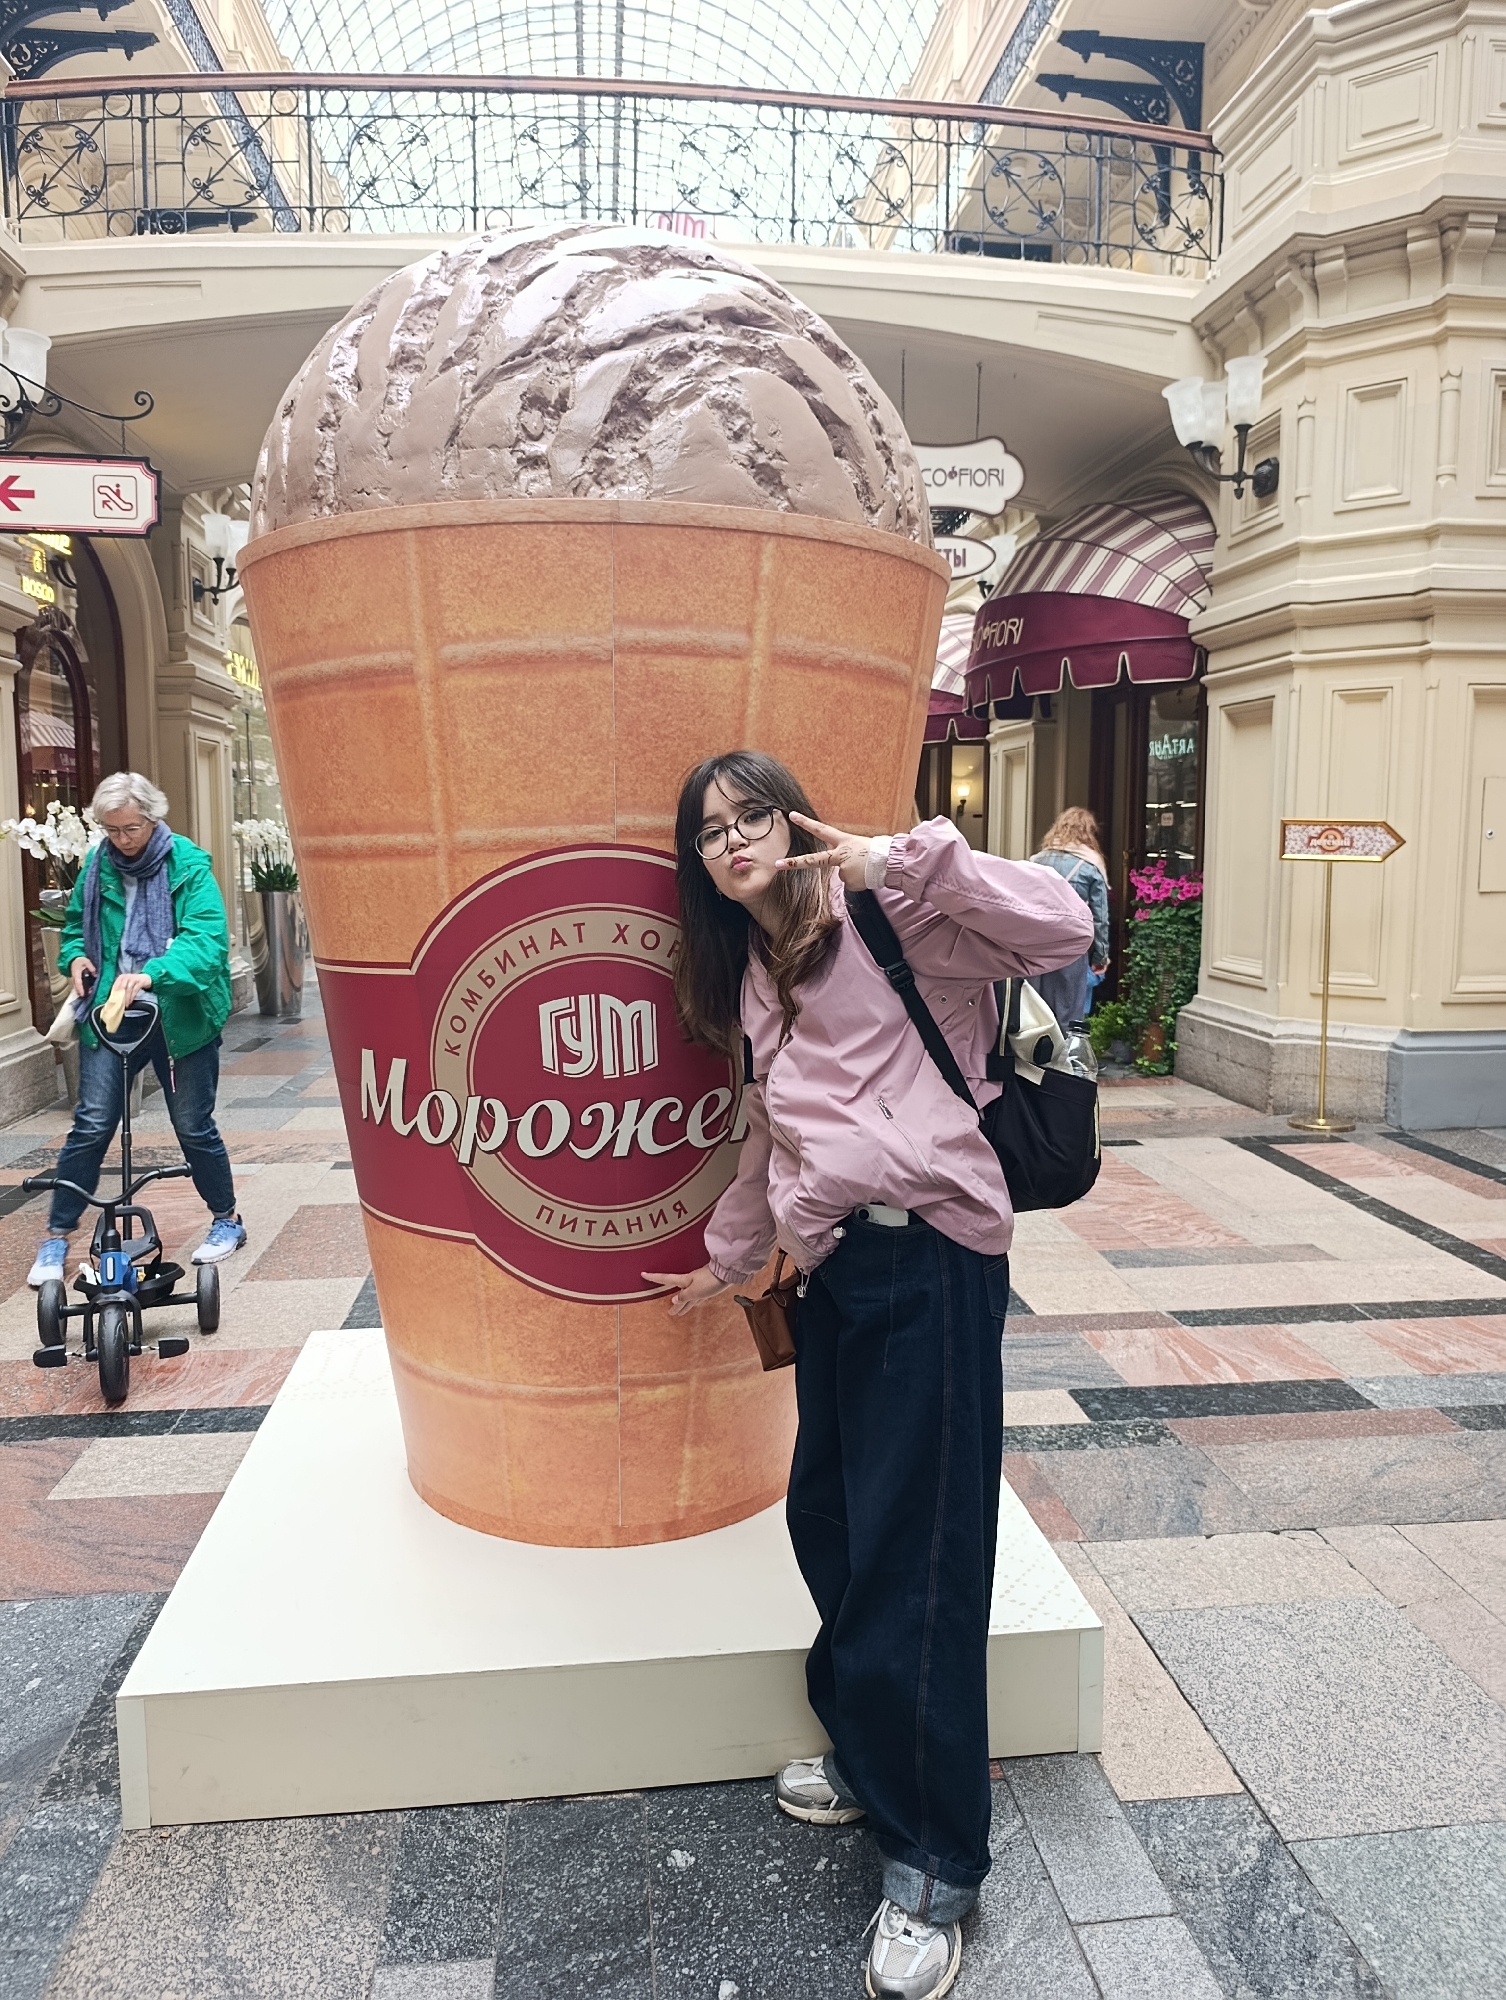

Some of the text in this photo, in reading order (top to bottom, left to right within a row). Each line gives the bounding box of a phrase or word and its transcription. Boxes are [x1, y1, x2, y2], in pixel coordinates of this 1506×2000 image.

[444, 922, 587, 1056] КОМБИНАТ
[538, 993, 659, 1079] ГУМ
[535, 1200, 688, 1236] ПИТАНИЯ
